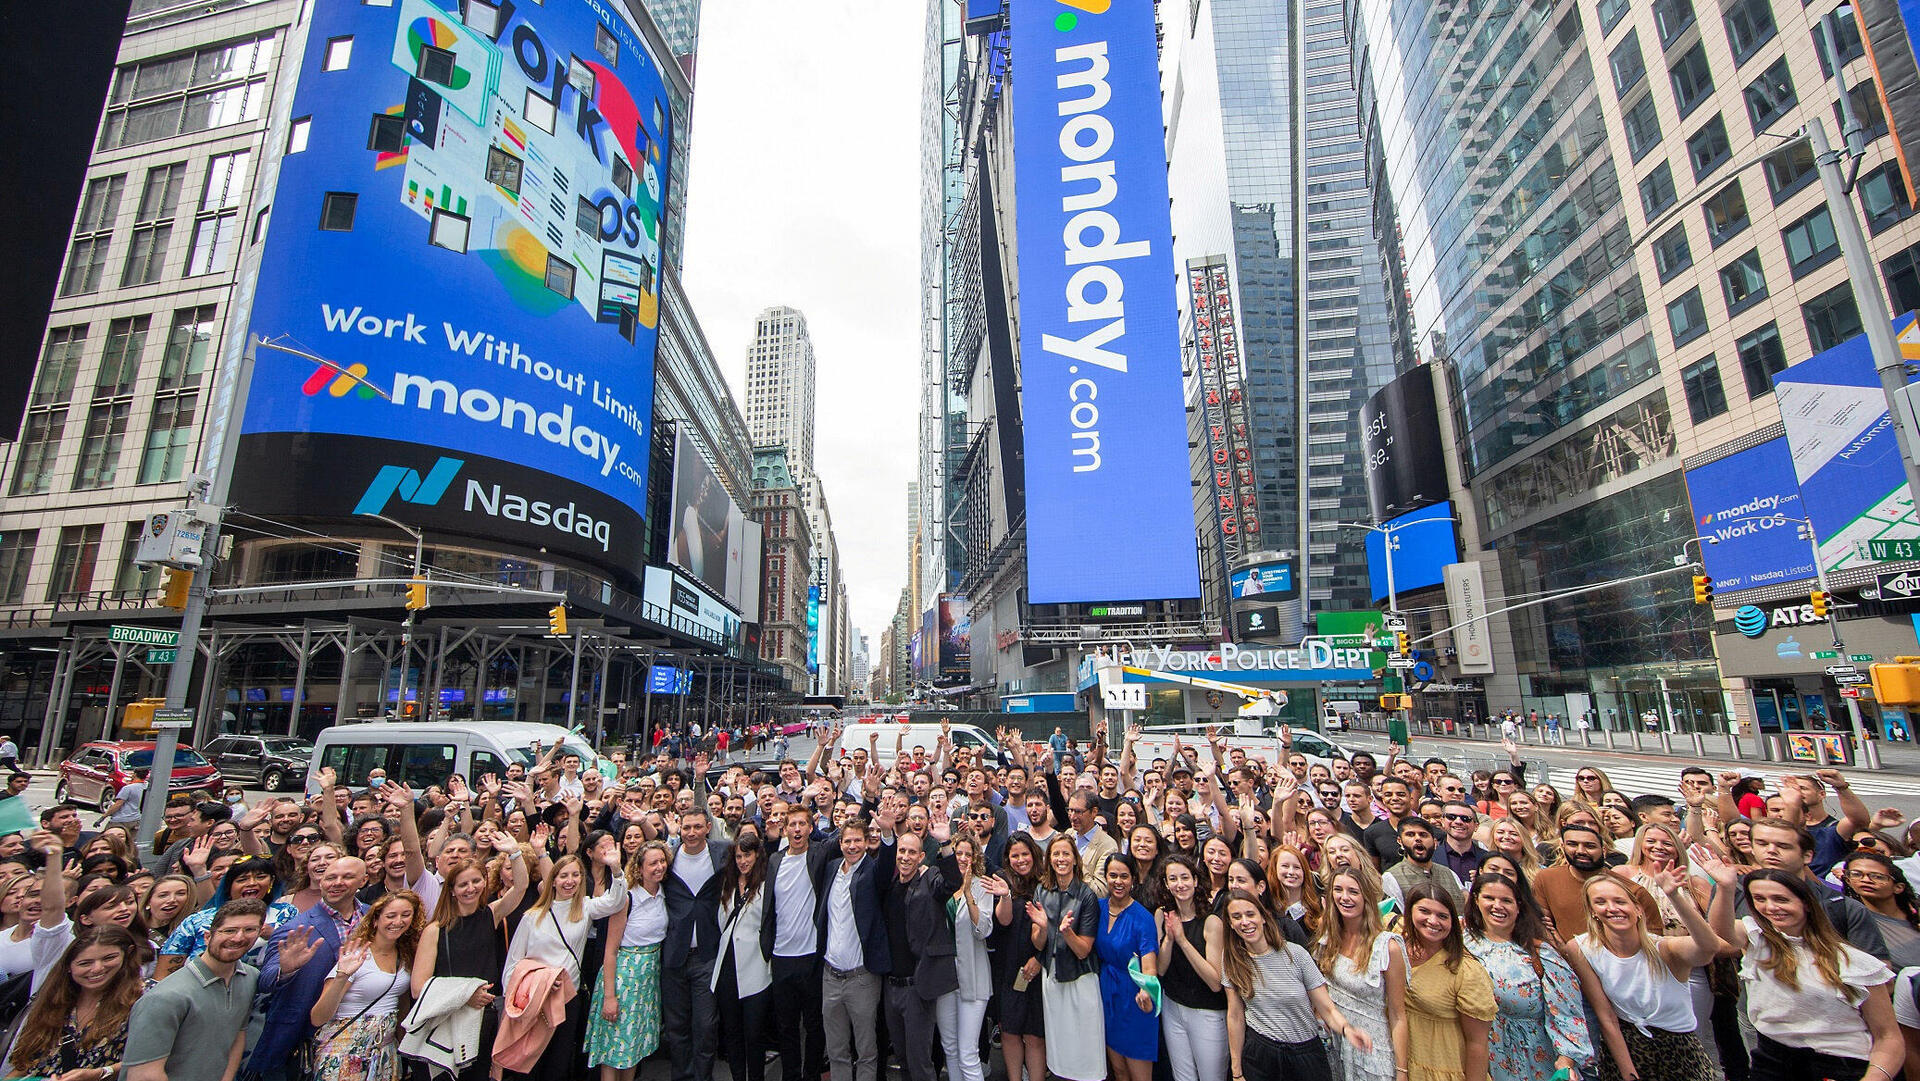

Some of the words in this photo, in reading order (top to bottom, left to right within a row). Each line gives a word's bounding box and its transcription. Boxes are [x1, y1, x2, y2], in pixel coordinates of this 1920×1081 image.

[612, 19, 646, 67] Listed
[598, 196, 641, 249] OS
[1041, 40, 1151, 473] monday.com
[1193, 275, 1212, 371] ERNST
[321, 303, 428, 345] Work
[442, 322, 587, 396] Without
[592, 379, 644, 437] Limits
[1208, 389, 1220, 404] &
[391, 371, 643, 489] monday.com
[1366, 411, 1388, 441] est
[1211, 425, 1237, 535] YOUNG
[464, 480, 611, 552] Nasdaq
[1716, 494, 1799, 521] monday.com
[1715, 520, 1759, 541] Work
[1759, 512, 1787, 530] OS
[1871, 542, 1887, 558] W
[1895, 542, 1913, 558] 43
[1716, 577, 1741, 588] MNDY
[1750, 570, 1784, 582] Nasdaq
[1784, 563, 1813, 576] Listed
[1895, 577, 1920, 590] ON
[1462, 577, 1473, 607] REUTERS
[1772, 604, 1830, 626] AT&
[112, 628, 176, 644] BROADWAY
[148, 652, 157, 662] W
[158, 651, 170, 662] 43
[1151, 643, 1215, 671] YORK
[1219, 642, 1299, 671] POLICE
[1307, 639, 1373, 669] DEPT
